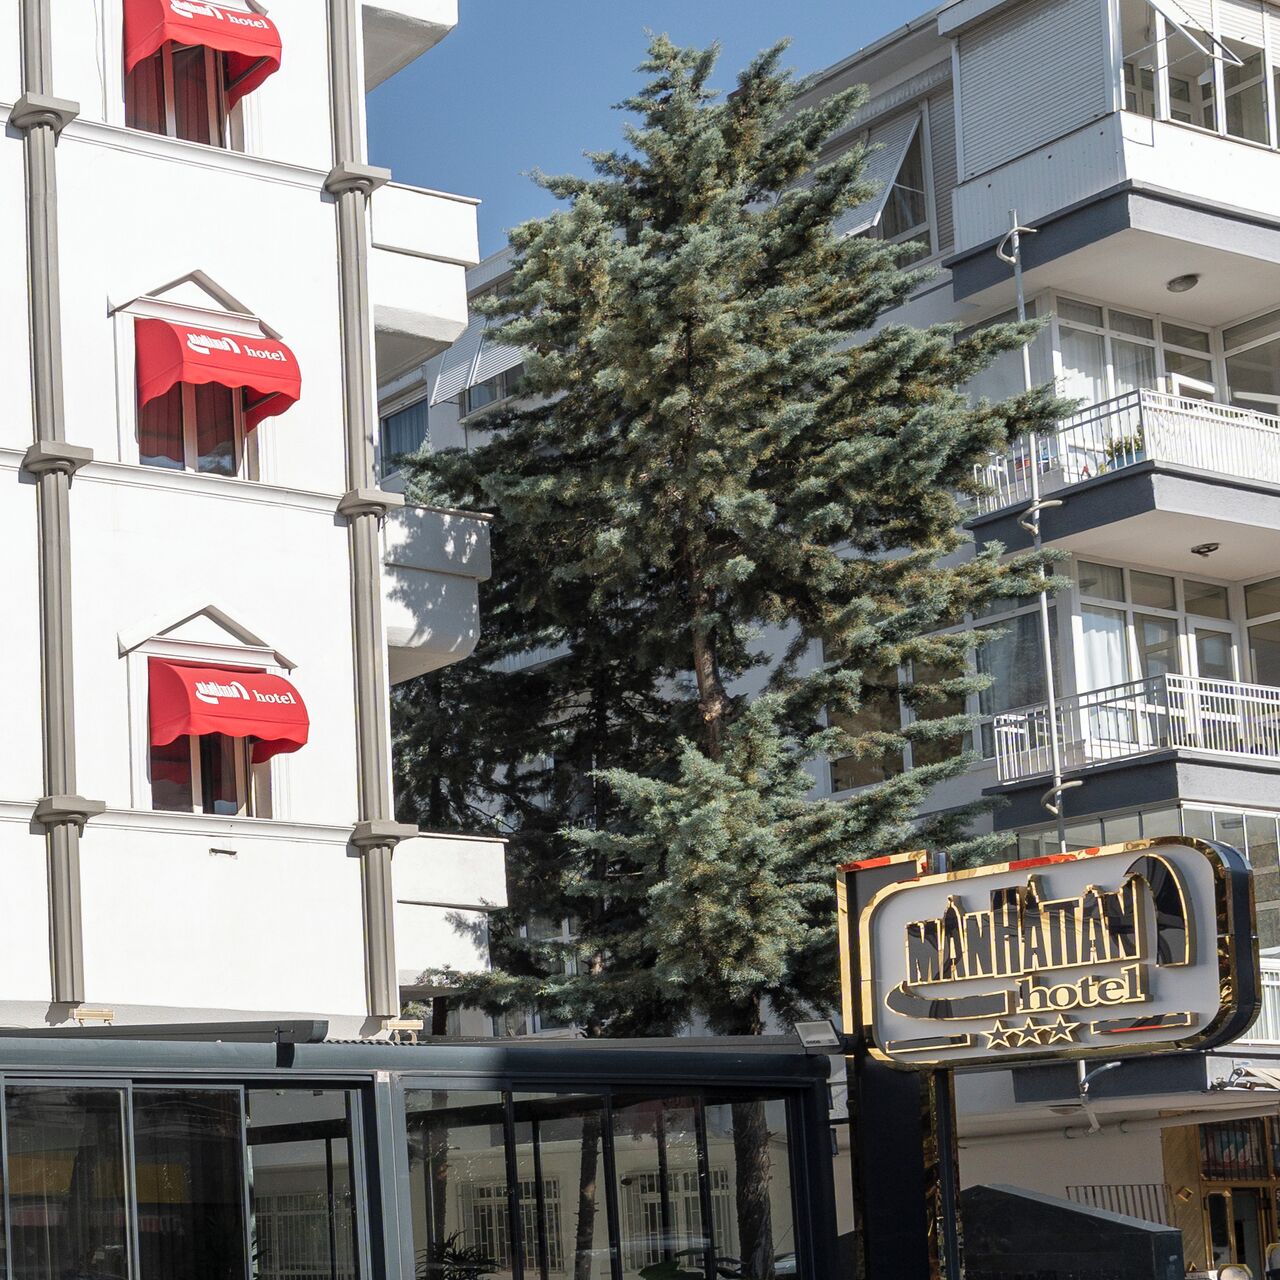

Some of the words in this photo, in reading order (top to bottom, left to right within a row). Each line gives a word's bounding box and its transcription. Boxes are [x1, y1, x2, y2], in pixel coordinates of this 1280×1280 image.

[225, 13, 270, 29] hotel
[243, 344, 287, 362] hotel
[252, 689, 297, 704] hotel
[905, 874, 1148, 987] MANHATTAN
[1016, 963, 1154, 1014] hotel
